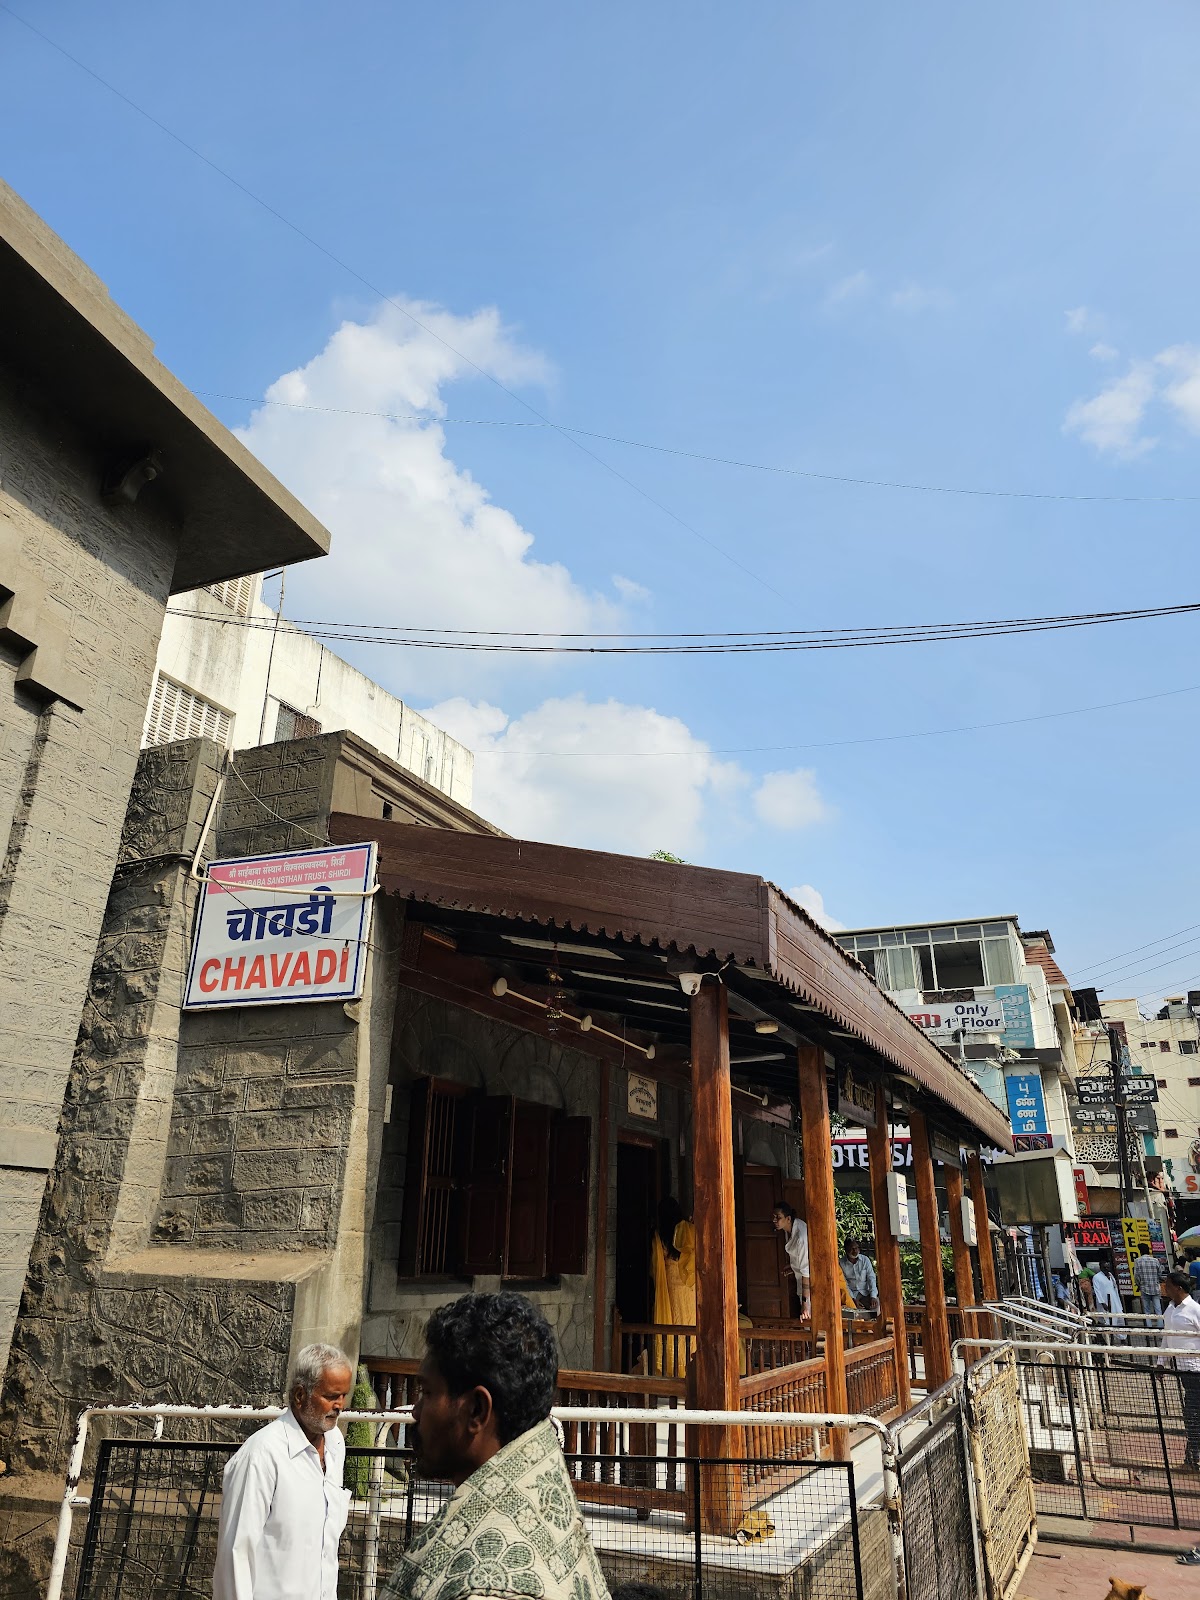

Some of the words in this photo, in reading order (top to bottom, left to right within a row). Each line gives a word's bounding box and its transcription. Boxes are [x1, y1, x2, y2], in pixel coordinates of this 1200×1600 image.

[229, 867, 237, 879] श्री
[267, 874, 303, 885] SANSTHAN
[304, 871, 326, 881] TRUST,
[328, 868, 351, 879] SHIRDI
[227, 885, 336, 942] चावडी
[199, 947, 350, 993] CHAVADI
[954, 1004, 989, 1017] Only
[961, 1017, 1001, 1028] Floor
[1082, 1095, 1107, 1103] Only
